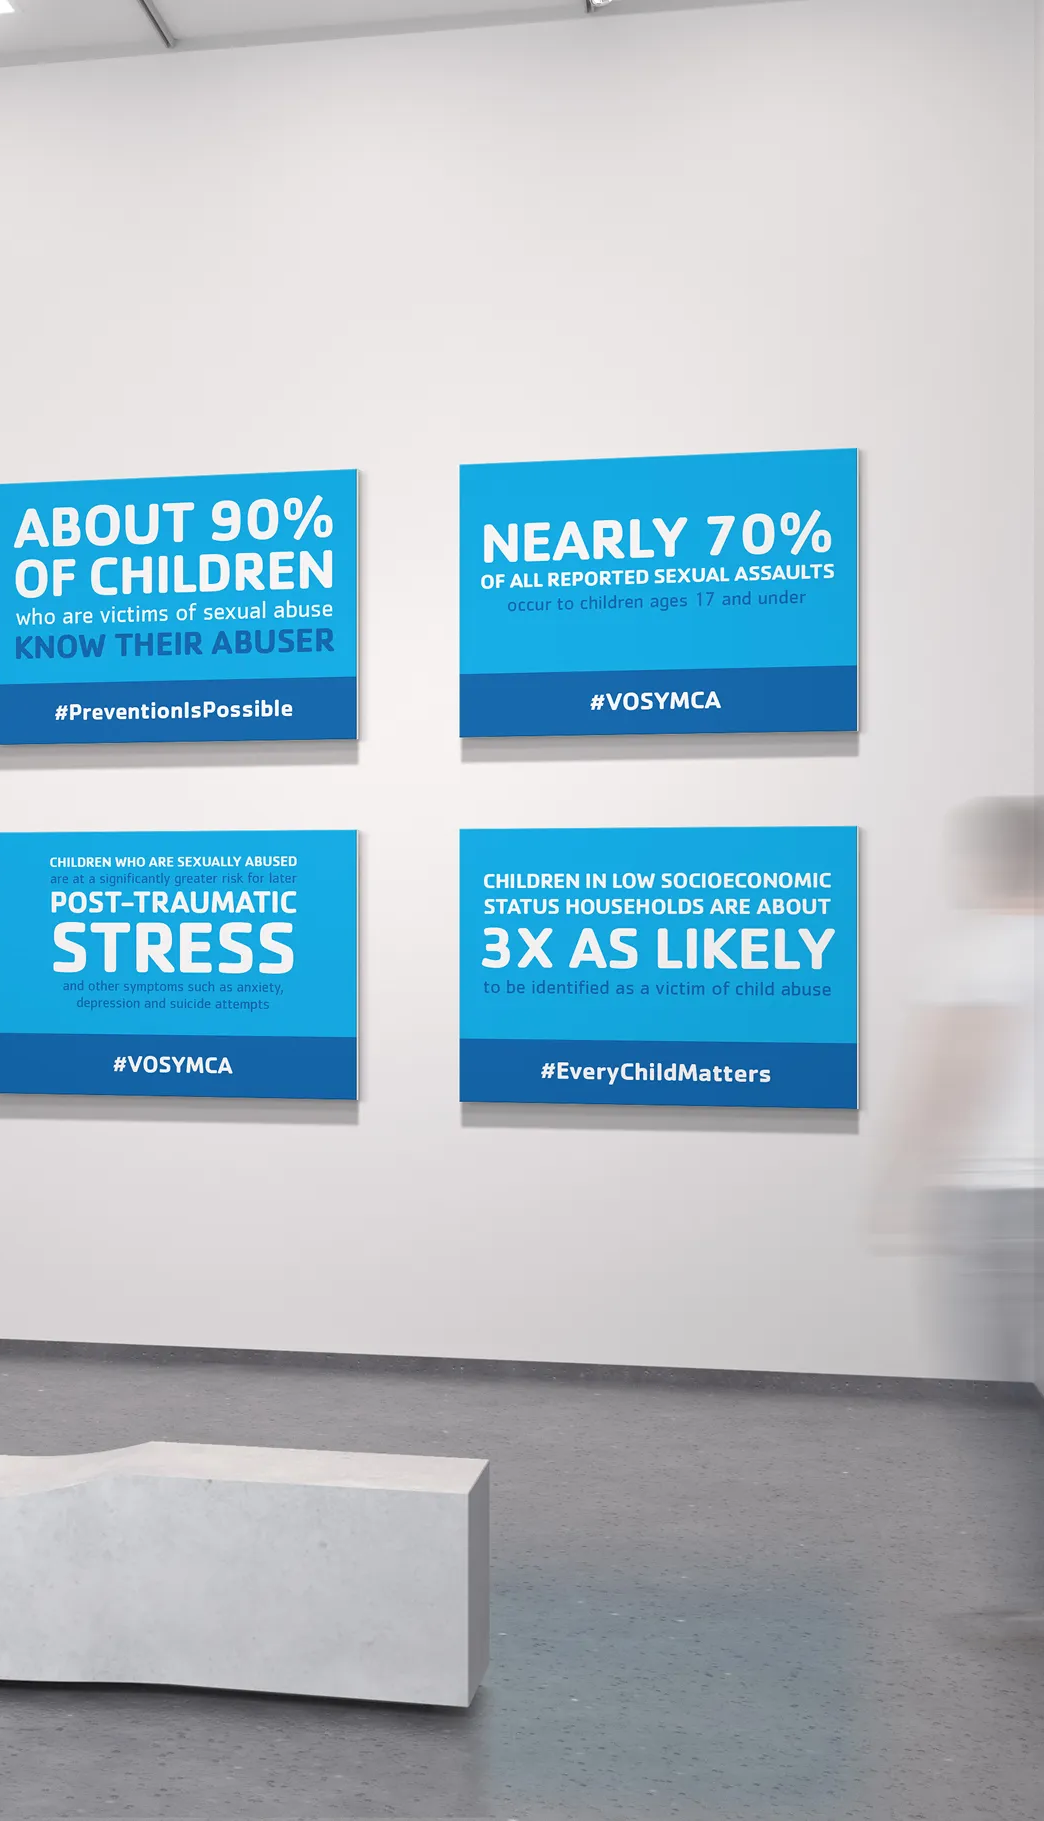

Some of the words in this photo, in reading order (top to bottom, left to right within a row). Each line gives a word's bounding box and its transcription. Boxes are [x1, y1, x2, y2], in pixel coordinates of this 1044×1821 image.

[13, 502, 195, 549] ABOUT
[211, 494, 333, 542] 90%
[483, 516, 688, 564] NEARLY
[706, 509, 832, 557] 70%
[15, 558, 76, 599] OF
[90, 549, 333, 596] CHILDREN
[480, 573, 506, 589] OF
[510, 572, 543, 588] ALL
[548, 569, 649, 587] REPORTED
[654, 567, 730, 584] SEXUAL
[734, 564, 835, 581] ASSAULTS
[507, 598, 552, 612] occur
[557, 596, 574, 611] to
[580, 593, 643, 610] children
[650, 594, 687, 612] ages
[696, 592, 715, 607] 17
[722, 591, 752, 606] and
[758, 590, 807, 605] under
[16, 608, 56, 625] who
[62, 610, 93, 624] are
[100, 606, 168, 623] victims
[176, 603, 197, 621] of
[203, 602, 267, 620] sexual
[273, 600, 333, 618] abuse
[15, 634, 106, 660] KNOW
[115, 631, 203, 656] THEIR
[211, 627, 335, 655] ABUSER
[55, 699, 293, 721] #PreventionIsPossible
[590, 691, 721, 711] #VOSYMCA
[50, 857, 112, 868] CHILDREN
[115, 857, 146, 868] WHO
[149, 856, 174, 867] ARE
[177, 856, 242, 867] SEXUALLY
[245, 856, 297, 867] ABUSED
[50, 874, 69, 885] are
[73, 873, 85, 884] at
[88, 874, 96, 884] a
[99, 872, 171, 887] significantly
[175, 873, 218, 887] greater
[221, 873, 244, 884] risk
[247, 872, 264, 884] for
[268, 872, 297, 884] later
[483, 873, 580, 889] CHILDREN
[585, 873, 606, 889] IN
[612, 873, 655, 889] LOW
[661, 872, 831, 888] SOCIOECONOMIC
[483, 898, 560, 914] STATUS
[565, 898, 704, 915] HOUSEHOLDS
[710, 898, 750, 915] ARE
[756, 898, 831, 915] ABOUT
[53, 921, 294, 974] STRESS
[481, 927, 553, 969] 3X
[569, 927, 638, 969] AS
[657, 928, 836, 969] LIKELY
[63, 980, 84, 991] and
[88, 980, 119, 992] other
[123, 981, 184, 994] symptoms
[188, 981, 215, 992] such
[219, 983, 232, 993] as
[236, 981, 284, 996] anxiety,
[483, 981, 501, 994] to
[506, 980, 525, 994] be
[531, 980, 609, 995] identified
[615, 982, 634, 995] as
[640, 983, 650, 995] a
[655, 980, 706, 996] victim
[712, 980, 730, 996] of
[735, 981, 774, 996] child
[781, 981, 832, 997] abuse
[76, 997, 140, 1011] depression
[144, 997, 166, 1009] and
[170, 998, 211, 1009] suicide
[215, 999, 269, 1012] attempts
[113, 1055, 233, 1074] #VOSYMCA
[541, 1061, 771, 1085] #EveryChildMatters
